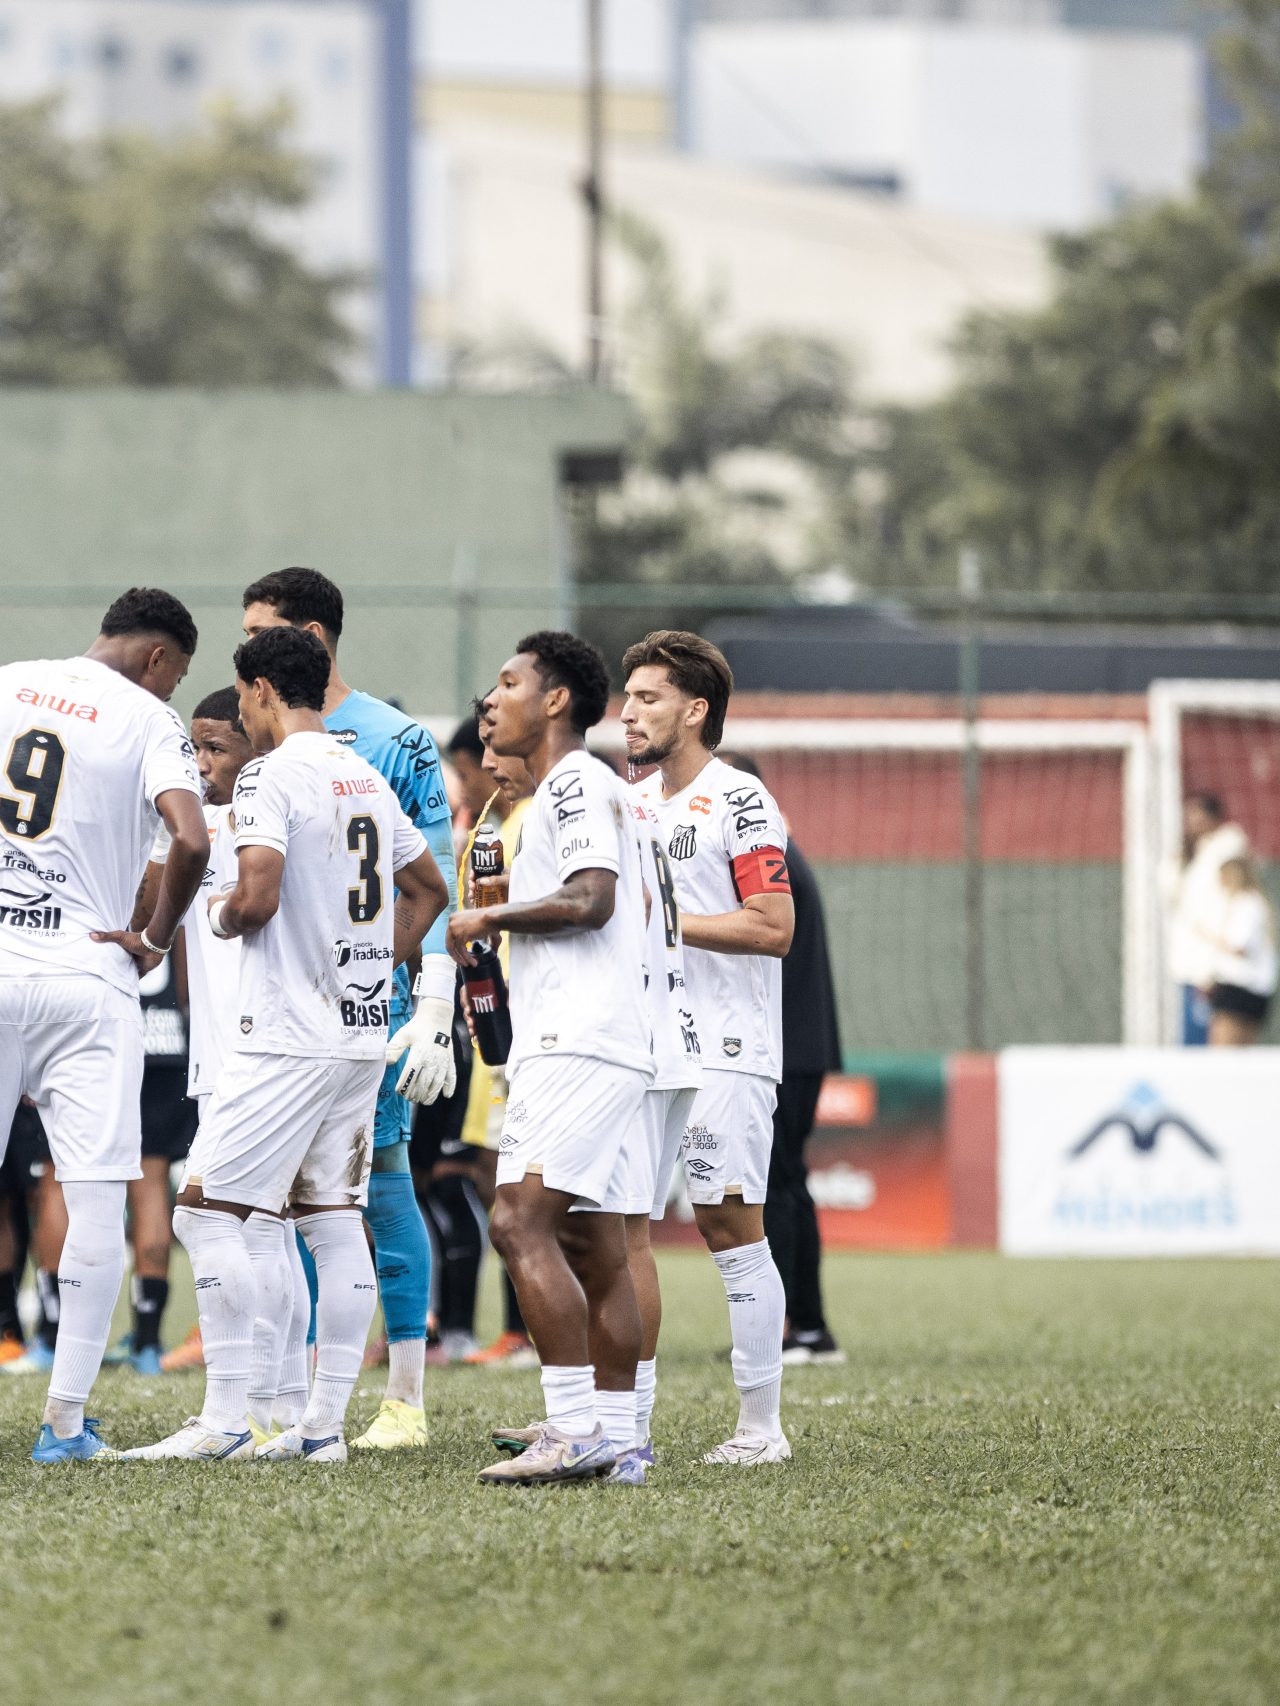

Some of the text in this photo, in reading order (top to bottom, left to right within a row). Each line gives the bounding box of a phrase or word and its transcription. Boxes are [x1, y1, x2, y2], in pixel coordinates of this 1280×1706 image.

[16, 687, 99, 724] aiwa
[332, 778, 379, 797] aiwa
[427, 789, 447, 809] all
[473, 848, 498, 866] TNT
[3, 854, 67, 883] Tradição
[346, 812, 385, 926] 3
[471, 994, 494, 1014] TNT
[692, 1134, 713, 1142] FOTO
[690, 1171, 711, 1181] umbro
